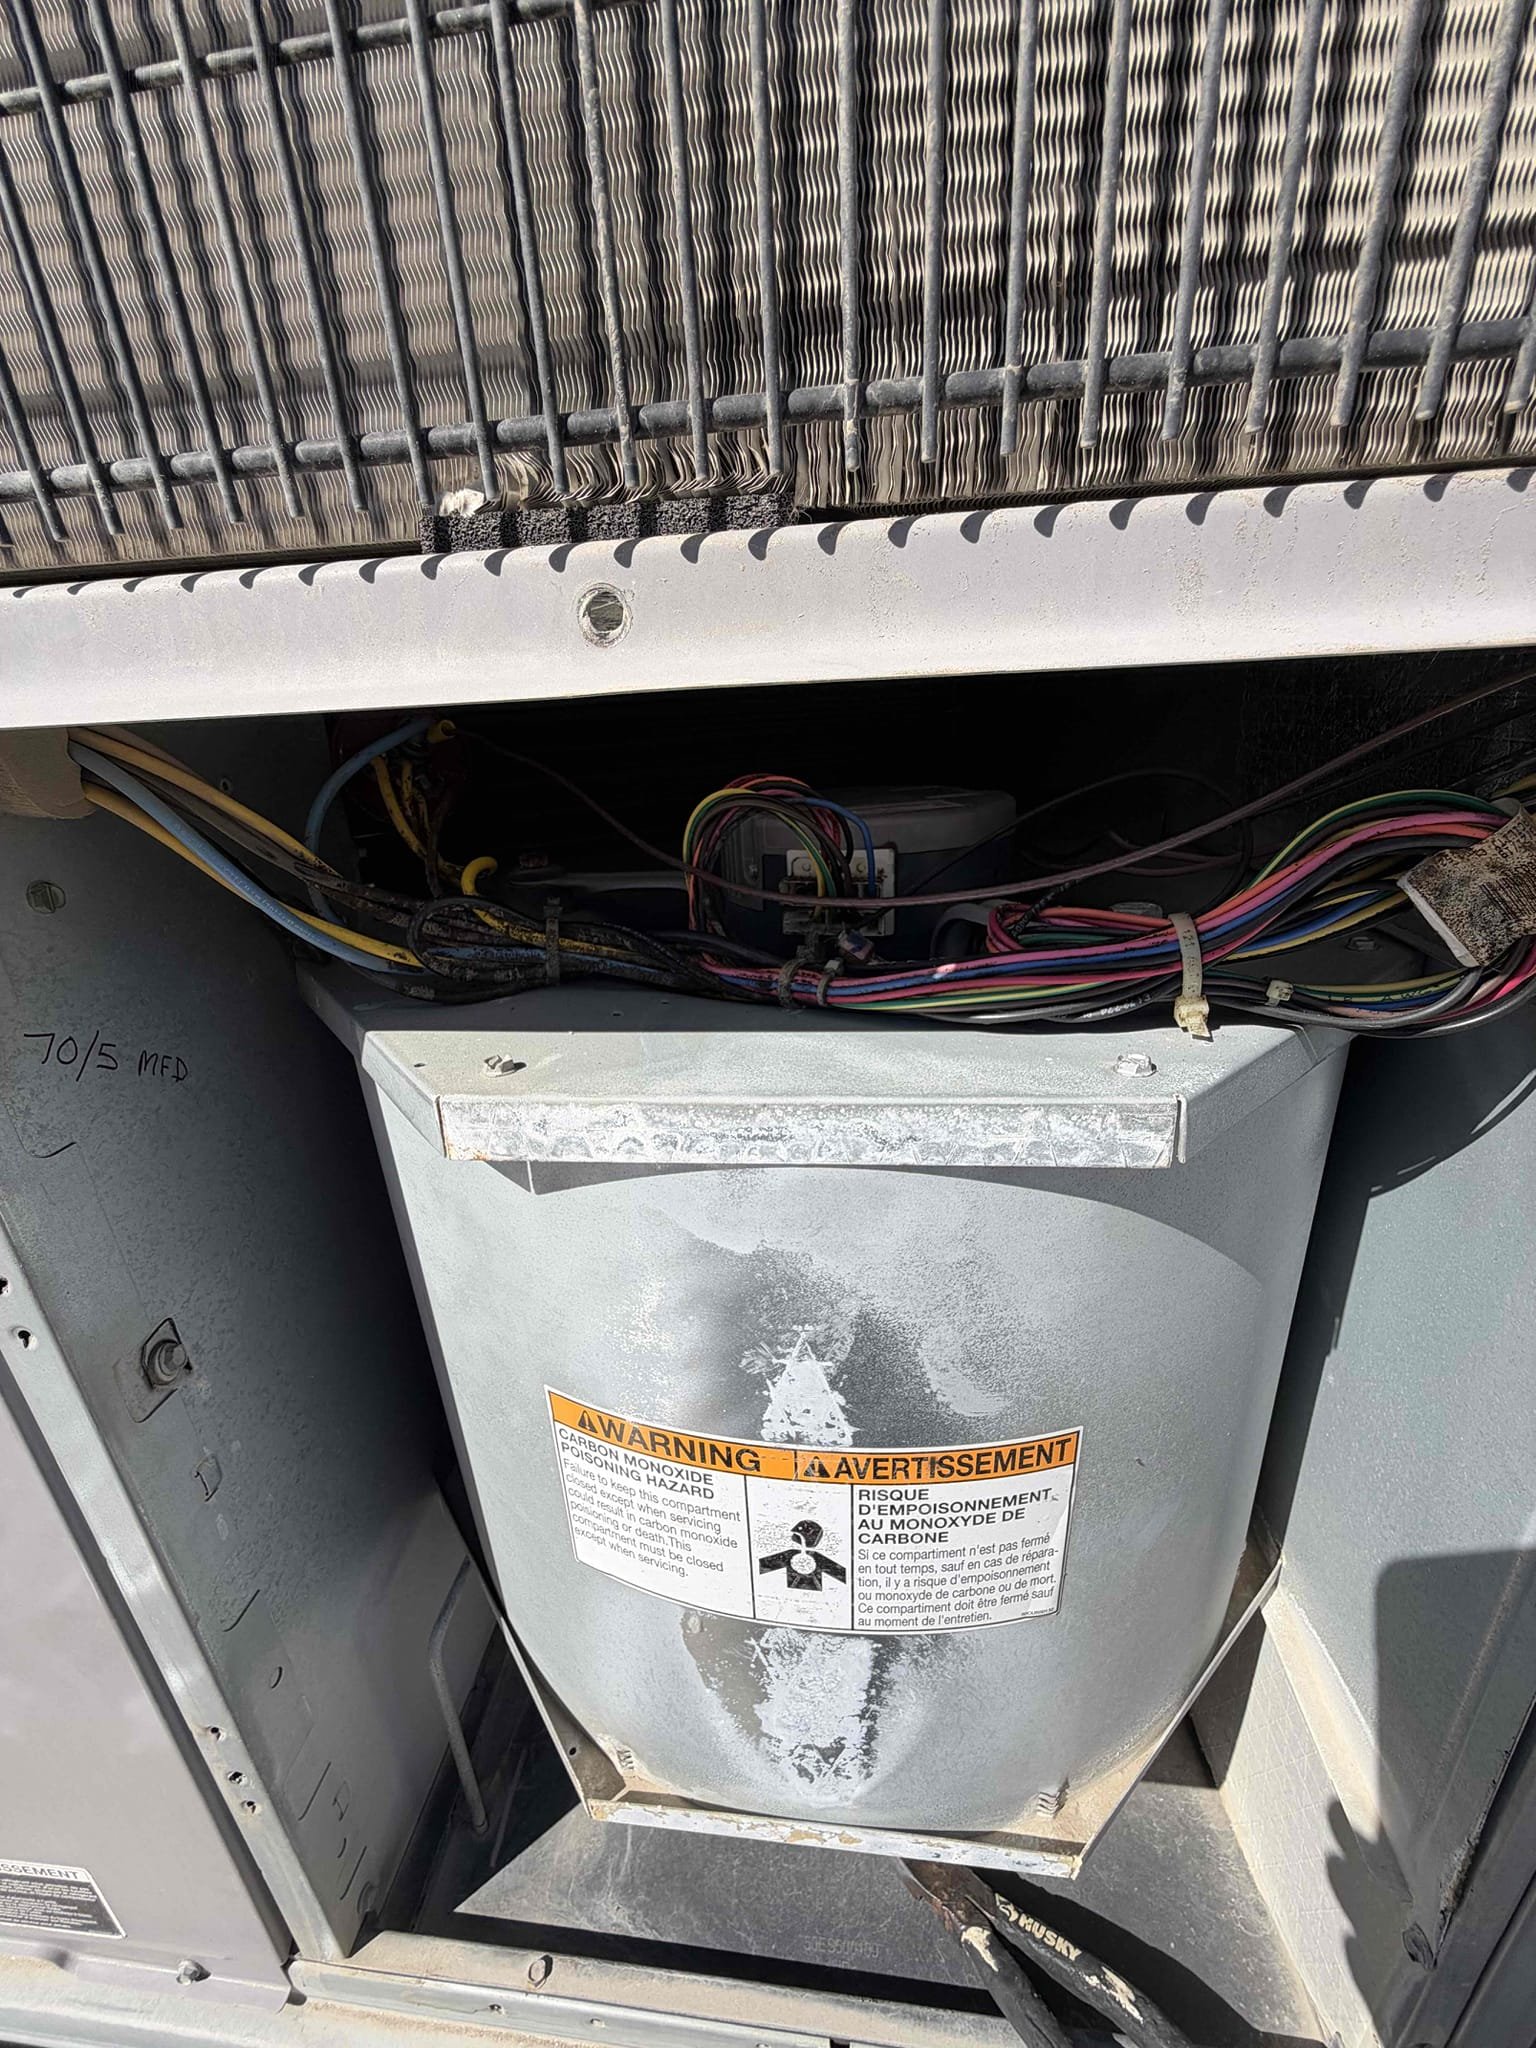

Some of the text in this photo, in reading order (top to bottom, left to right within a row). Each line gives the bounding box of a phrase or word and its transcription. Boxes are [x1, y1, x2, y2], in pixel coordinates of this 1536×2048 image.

[24, 1030, 188, 1082] 70/5 MFD
[559, 1428, 713, 1486] CARBON MONOXIDE
[597, 1414, 760, 1472] WARNING
[561, 1441, 714, 1499] POISONING HAZARD
[834, 1438, 1072, 1480] AVERTISSEMENT
[563, 1458, 741, 1521] Failure to keep this compartment
[566, 1473, 721, 1535] closed except when servicing
[858, 1488, 929, 1501] RISQUE
[858, 1488, 1052, 1516] D'EMPOISONNEMENT
[568, 1487, 738, 1548] could result in carbon monoxide
[621, 1523, 632, 1533] or
[858, 1508, 1025, 1530] AU MONOXYDE DE
[572, 1513, 723, 1572] compartment must be closed
[574, 1527, 688, 1577] except when servicing.
[858, 1531, 949, 1544] CARBONE
[858, 1532, 1050, 1562] Si ce compartiment n'est pas fermé
[858, 1547, 1059, 1576] en tout temps, sauf en cas de répara-
[858, 1560, 1050, 1590] tion, il y a risque d'empoisonnement
[858, 1573, 1056, 1603] ou monoxyde de carbone ou de mort.
[858, 1586, 1054, 1616] Ce compartiment doit être fermé sauf
[858, 1617, 871, 1626] au
[874, 1617, 918, 1627] moment
[921, 1616, 935, 1626] de
[0, 1863, 79, 1880] SSEMENT
[1018, 1912, 1082, 1961] HUSKY
